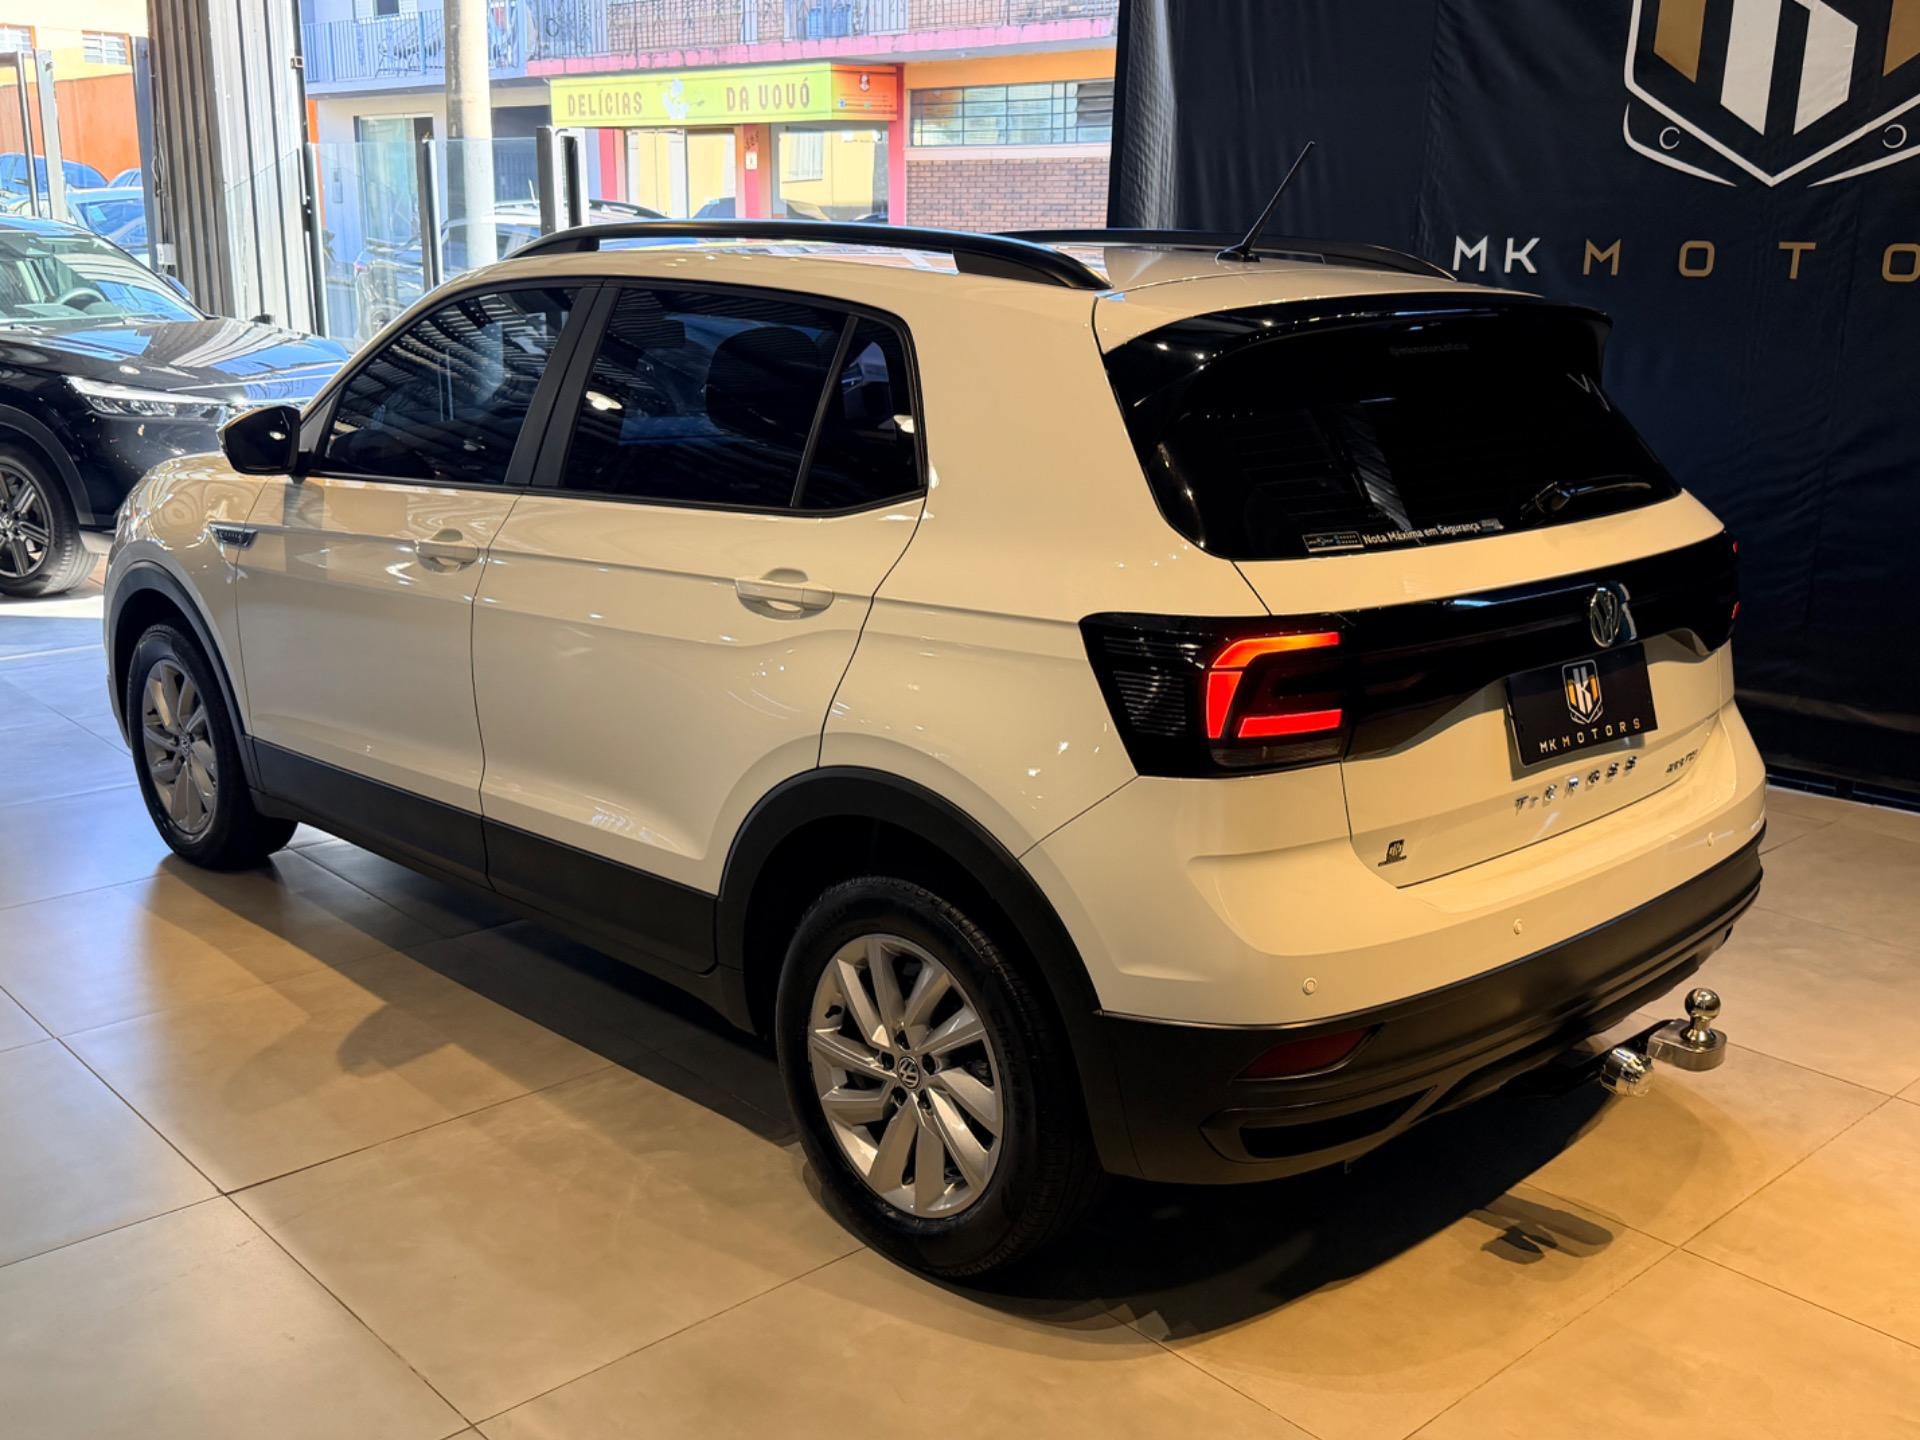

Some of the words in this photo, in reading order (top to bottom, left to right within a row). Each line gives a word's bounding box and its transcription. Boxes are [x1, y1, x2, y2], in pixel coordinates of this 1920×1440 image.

[567, 88, 643, 117] DELÍCIAS
[726, 86, 750, 112] DA
[1362, 533, 1388, 545] Nota
[1389, 529, 1424, 544] Máxima
[1424, 528, 1439, 537] em
[1437, 521, 1481, 538] Segurança
